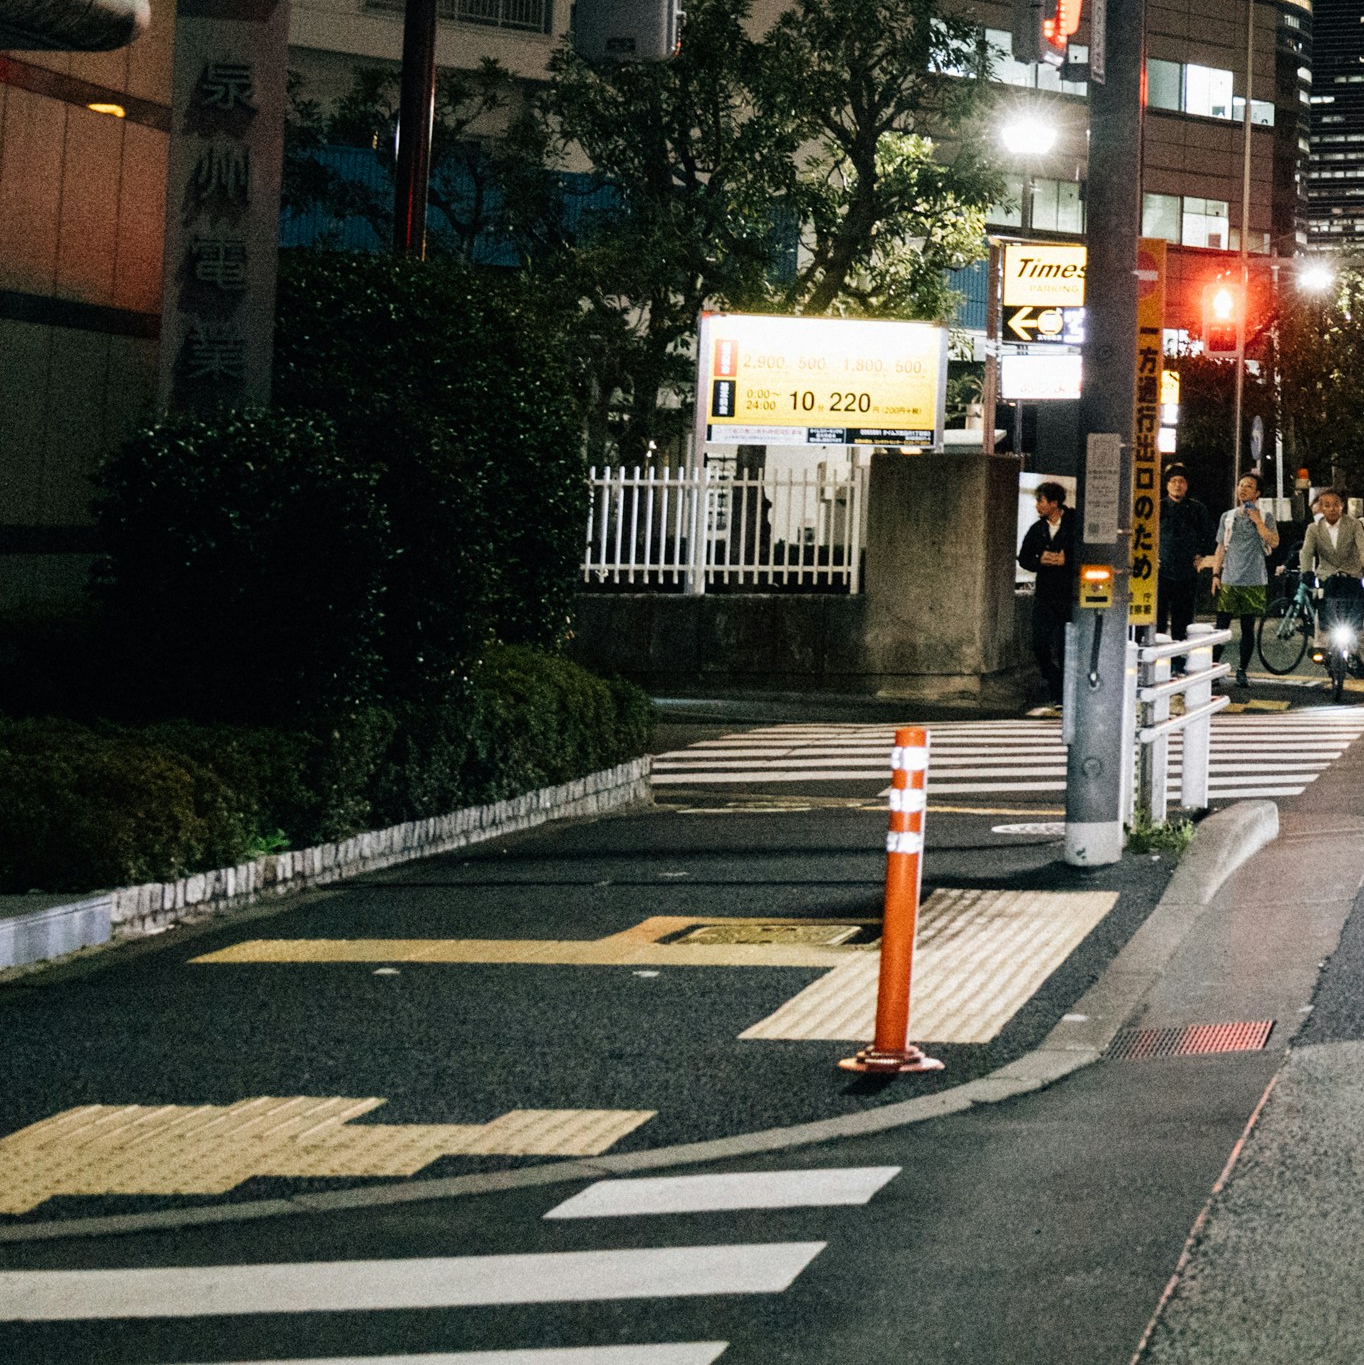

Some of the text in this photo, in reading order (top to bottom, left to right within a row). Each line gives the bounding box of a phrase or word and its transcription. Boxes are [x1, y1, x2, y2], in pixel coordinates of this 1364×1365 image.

[1029, 284, 1080, 293] PARKING
[746, 400, 777, 411] 24:00
[1132, 326, 1160, 581] 一方通行出口のため
